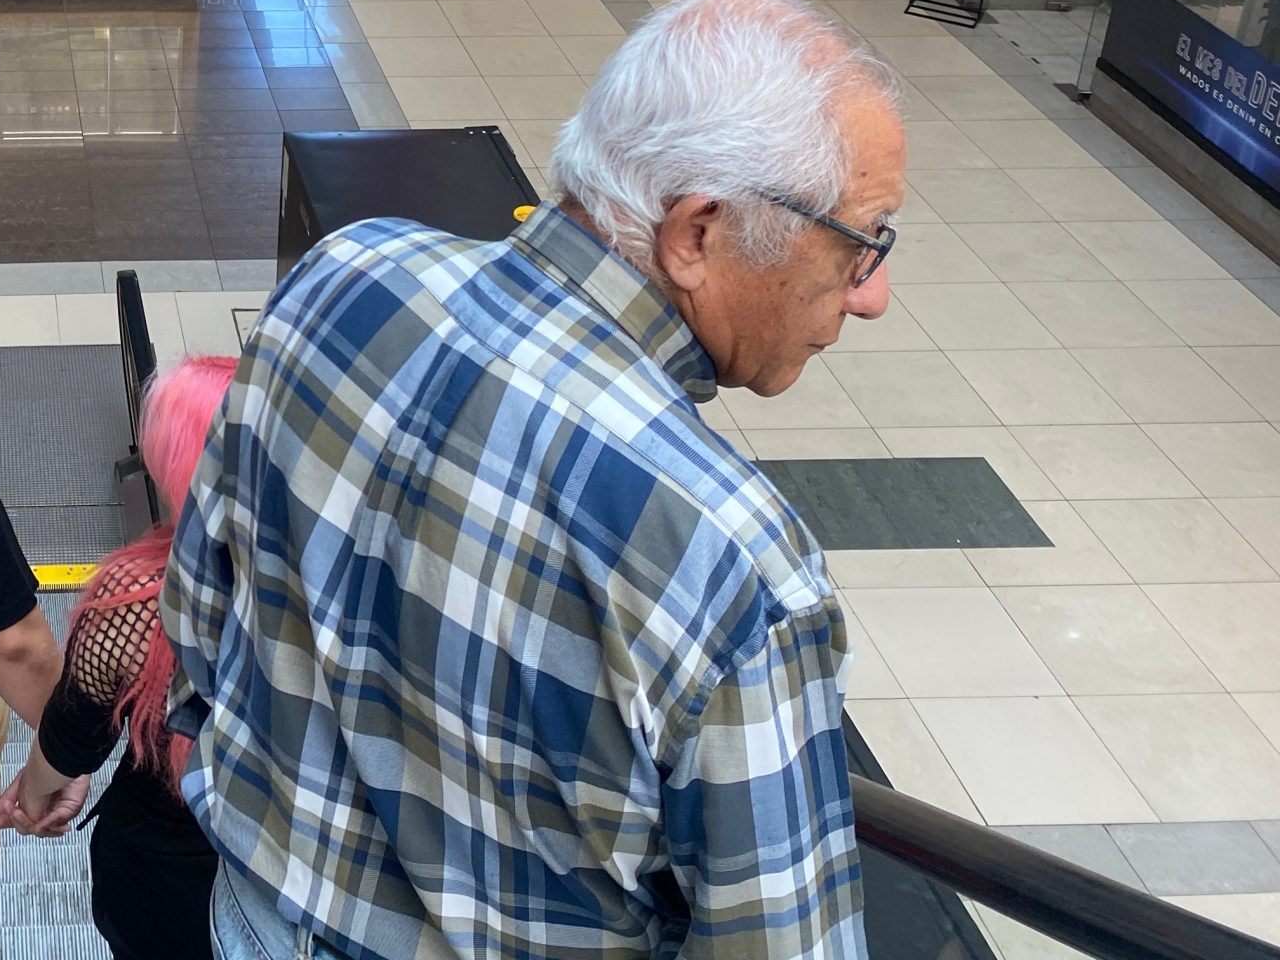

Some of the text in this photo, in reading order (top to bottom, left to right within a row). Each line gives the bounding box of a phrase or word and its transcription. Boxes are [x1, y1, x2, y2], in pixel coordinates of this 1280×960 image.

[1178, 64, 1272, 138] WADOS ES DENIM EN
